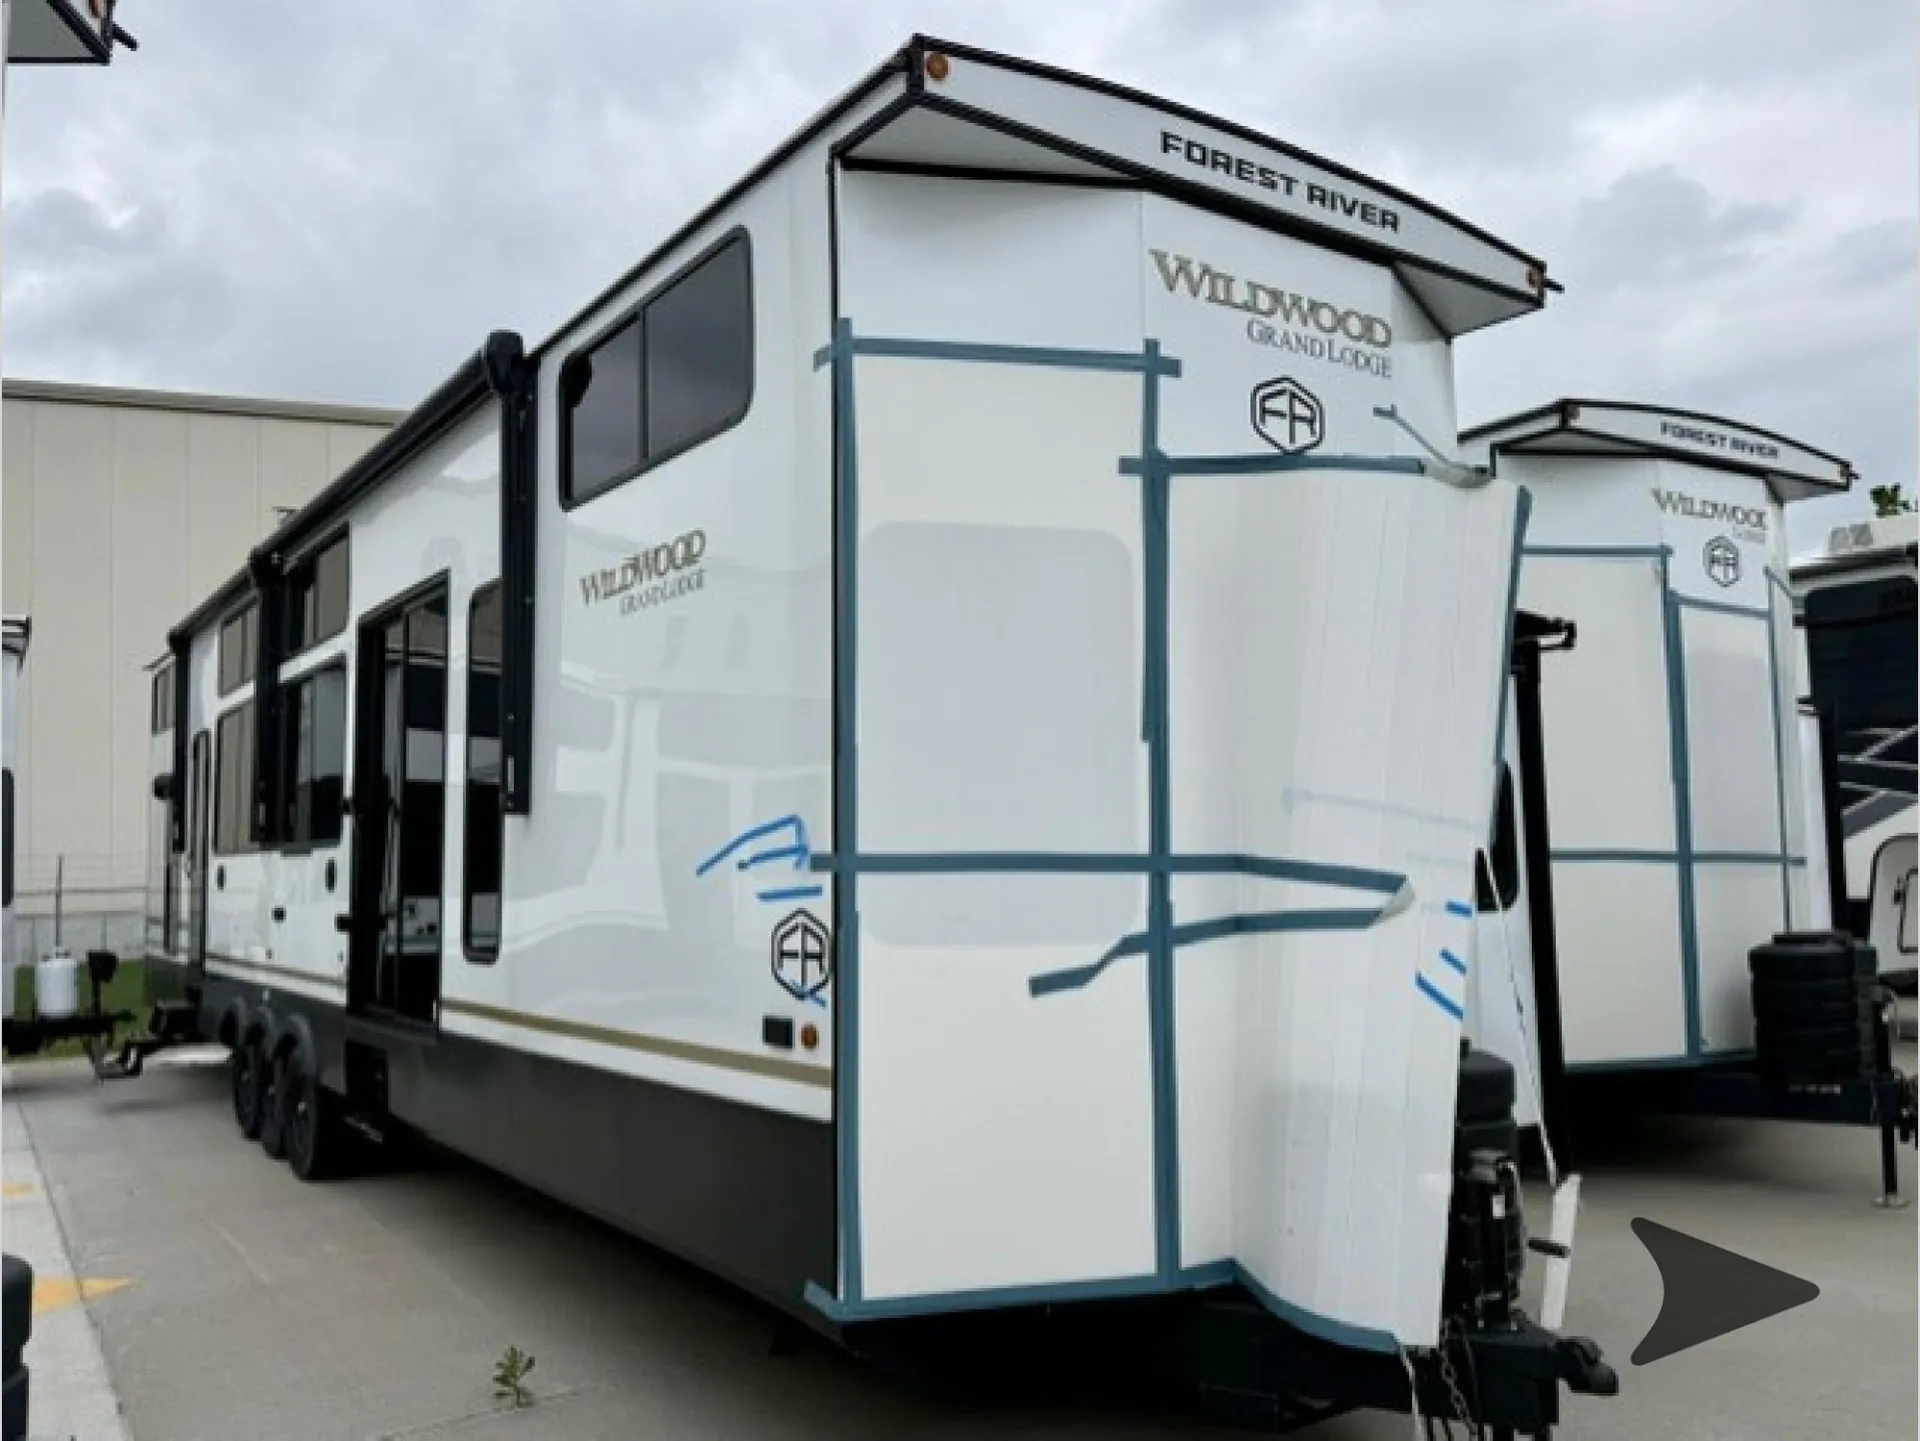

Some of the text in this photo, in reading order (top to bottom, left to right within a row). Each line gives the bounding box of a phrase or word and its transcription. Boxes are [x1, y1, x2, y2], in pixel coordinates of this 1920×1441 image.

[1160, 130, 1399, 233] FOREST RIVER
[1149, 248, 1392, 348] WILDWOOD
[1246, 318, 1392, 378] GRAND LODGE
[578, 529, 707, 607] WILDWOOD
